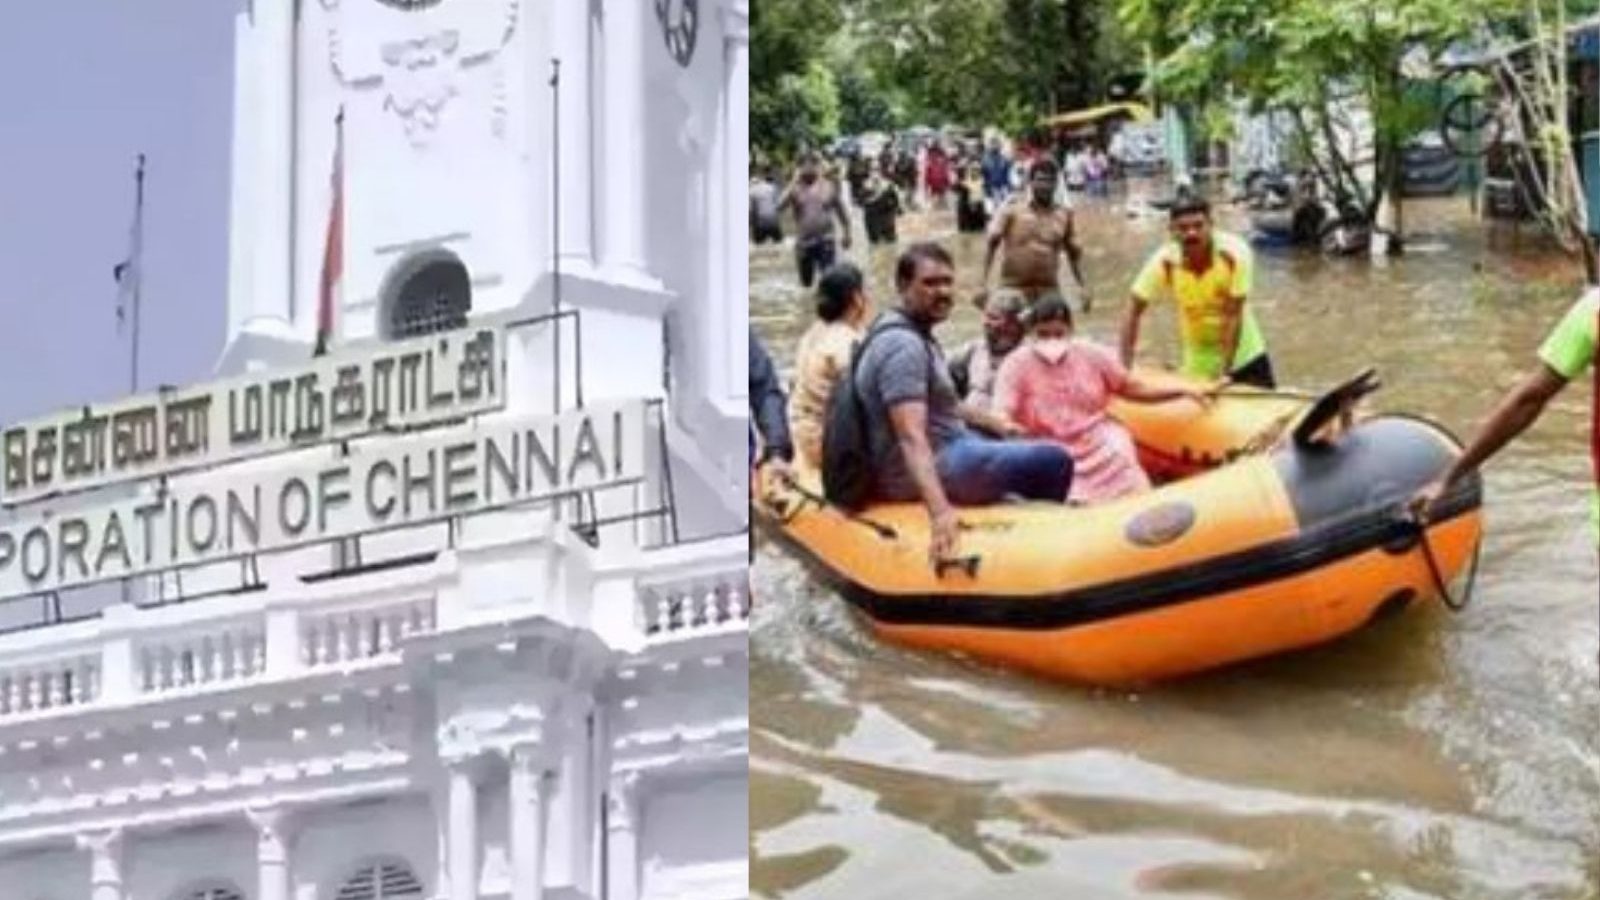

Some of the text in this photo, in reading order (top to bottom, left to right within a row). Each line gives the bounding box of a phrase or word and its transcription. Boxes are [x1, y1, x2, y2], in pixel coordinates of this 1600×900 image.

[4, 330, 494, 490] சென்னை மாநகராட்சி
[277, 467, 350, 537] OF
[365, 411, 623, 521] CHENNAI
